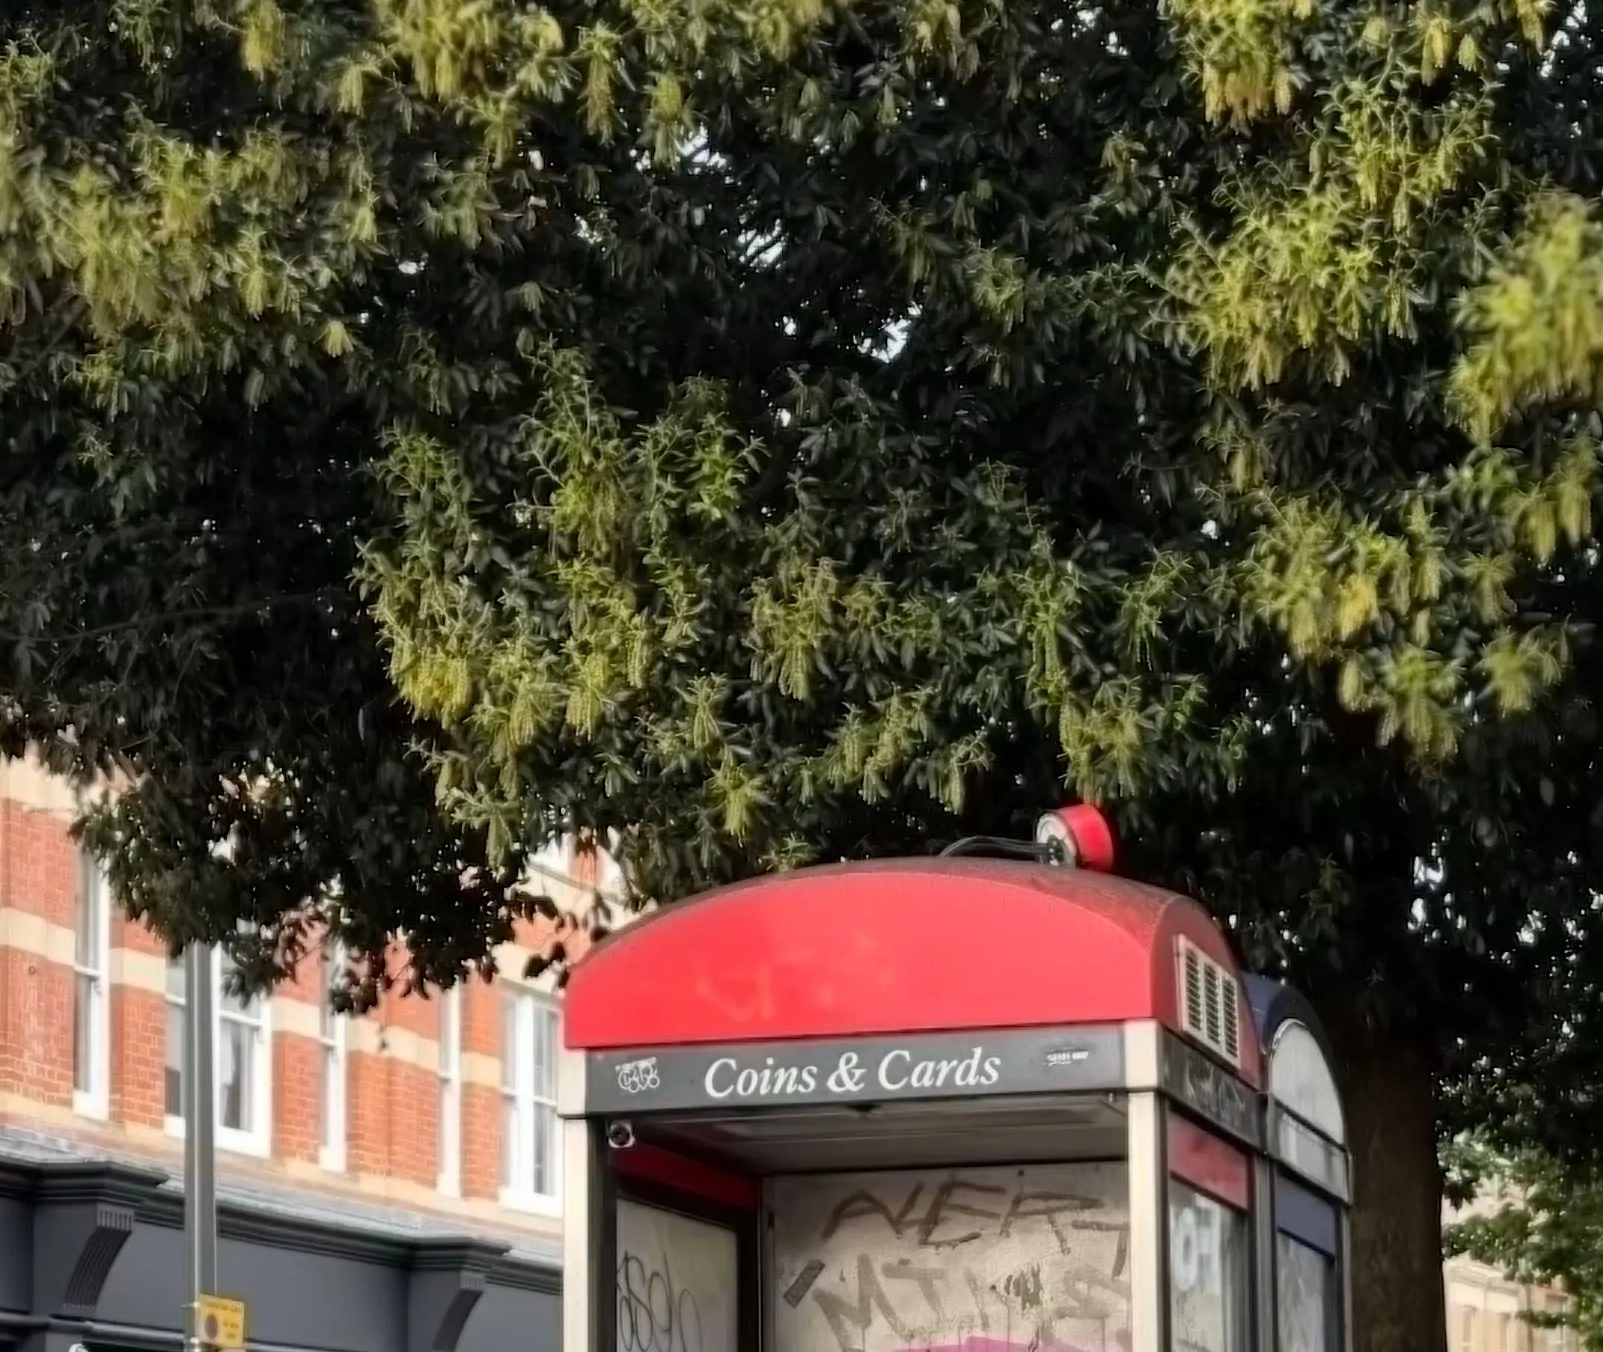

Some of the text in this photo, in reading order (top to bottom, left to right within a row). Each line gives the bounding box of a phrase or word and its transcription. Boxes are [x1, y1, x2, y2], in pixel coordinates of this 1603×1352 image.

[704, 1056, 817, 1097] Coins
[826, 1052, 866, 1092] &
[877, 1047, 1002, 1089] Cards
